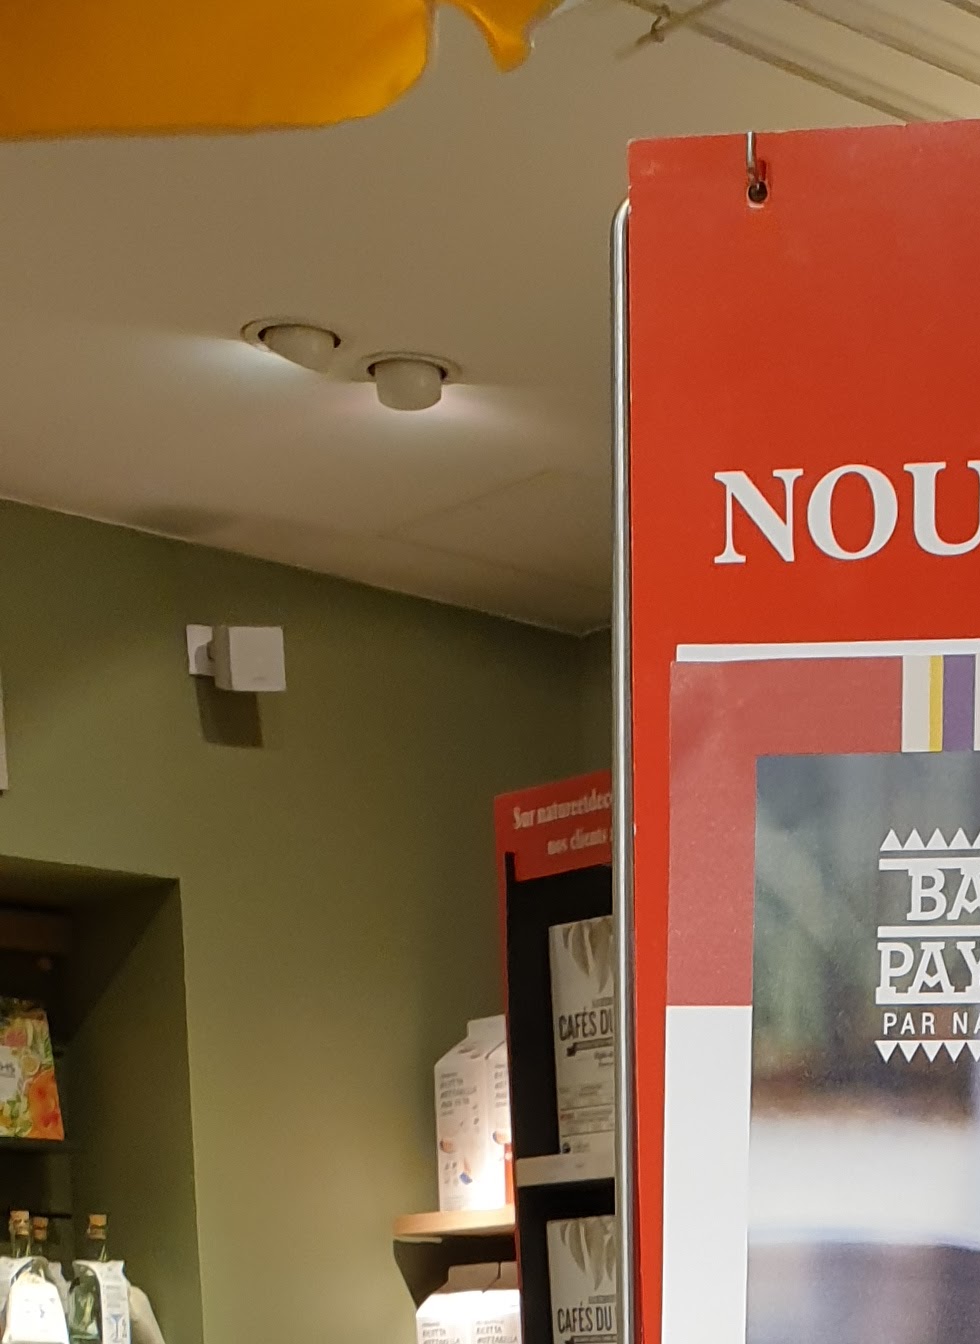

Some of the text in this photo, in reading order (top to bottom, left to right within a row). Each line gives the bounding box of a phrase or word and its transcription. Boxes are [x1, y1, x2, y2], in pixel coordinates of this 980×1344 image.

[513, 807, 535, 829] Sur
[558, 1006, 598, 1041] CAFÉS
[883, 1012, 934, 1035] PAR
[557, 1302, 613, 1334] CAFÉS DU
